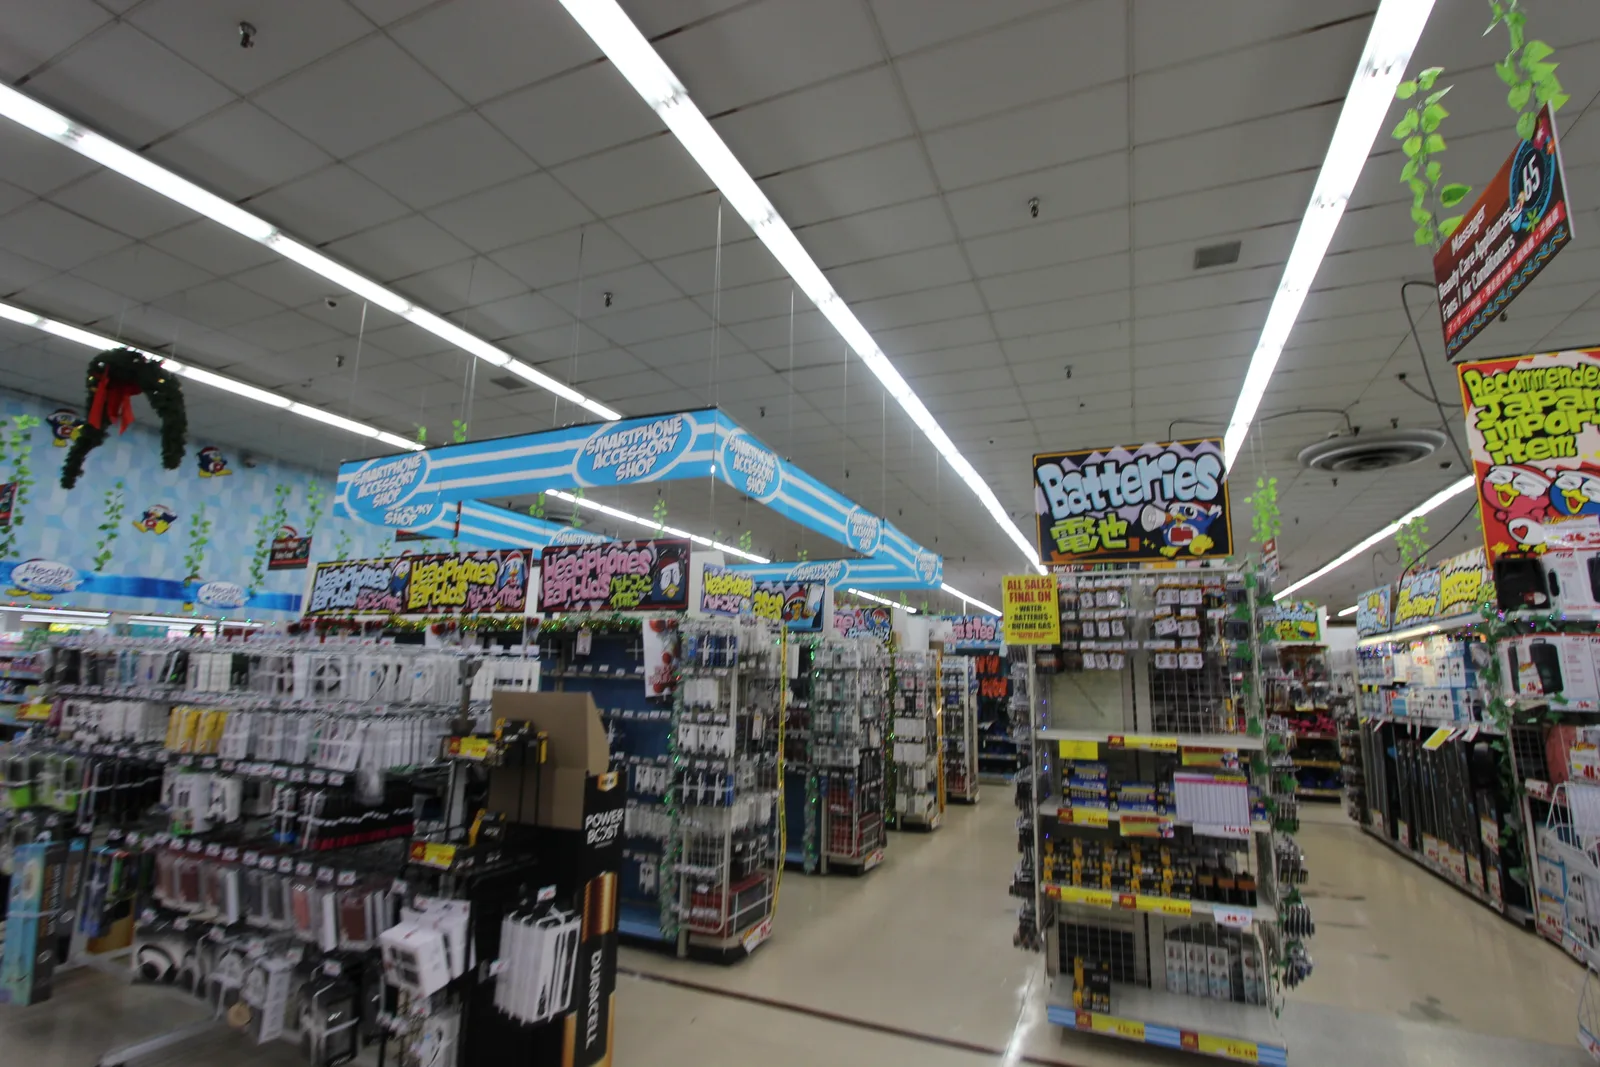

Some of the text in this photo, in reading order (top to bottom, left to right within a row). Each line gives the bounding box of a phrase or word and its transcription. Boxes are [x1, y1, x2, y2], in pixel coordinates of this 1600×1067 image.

[1522, 154, 1541, 200] 65
[1451, 203, 1486, 256] Massager
[1458, 250, 1476, 278] Care
[1474, 206, 1513, 261] Appliances
[1442, 297, 1459, 322] Fans
[1462, 279, 1473, 302] Air
[1471, 233, 1516, 291] Conditioners
[1463, 362, 1600, 398] Recommende
[584, 415, 684, 456] SMARTPHONE
[1485, 434, 1577, 466] item
[592, 435, 679, 470] ACCESSORY
[353, 453, 422, 487] SMARTPHONE
[615, 457, 656, 482] SHOP
[356, 469, 419, 500] ACCESSORY
[372, 488, 401, 509] SHOP
[1037, 453, 1220, 520] Batteries
[384, 511, 418, 527] SHOP
[24, 563, 73, 578] Health
[316, 564, 392, 591] Headphones
[410, 559, 498, 591] Headphones
[543, 548, 652, 583] Headphones
[207, 583, 242, 595] Health
[407, 581, 467, 610] Earbuds
[543, 573, 611, 608] Earbuds
[704, 571, 752, 598] Headphones
[1007, 578, 1053, 590] ALL SALES
[1009, 590, 1052, 603] FINAL ON
[310, 586, 359, 612] Earbuds
[752, 590, 784, 620] ases
[1019, 604, 1042, 612] WATER
[1012, 622, 1036, 630] BUTANE
[1014, 613, 1049, 621] BATTERIES
[585, 807, 625, 830] POWER
[586, 822, 620, 845] BOOST
[585, 949, 602, 1050] DURACELL
